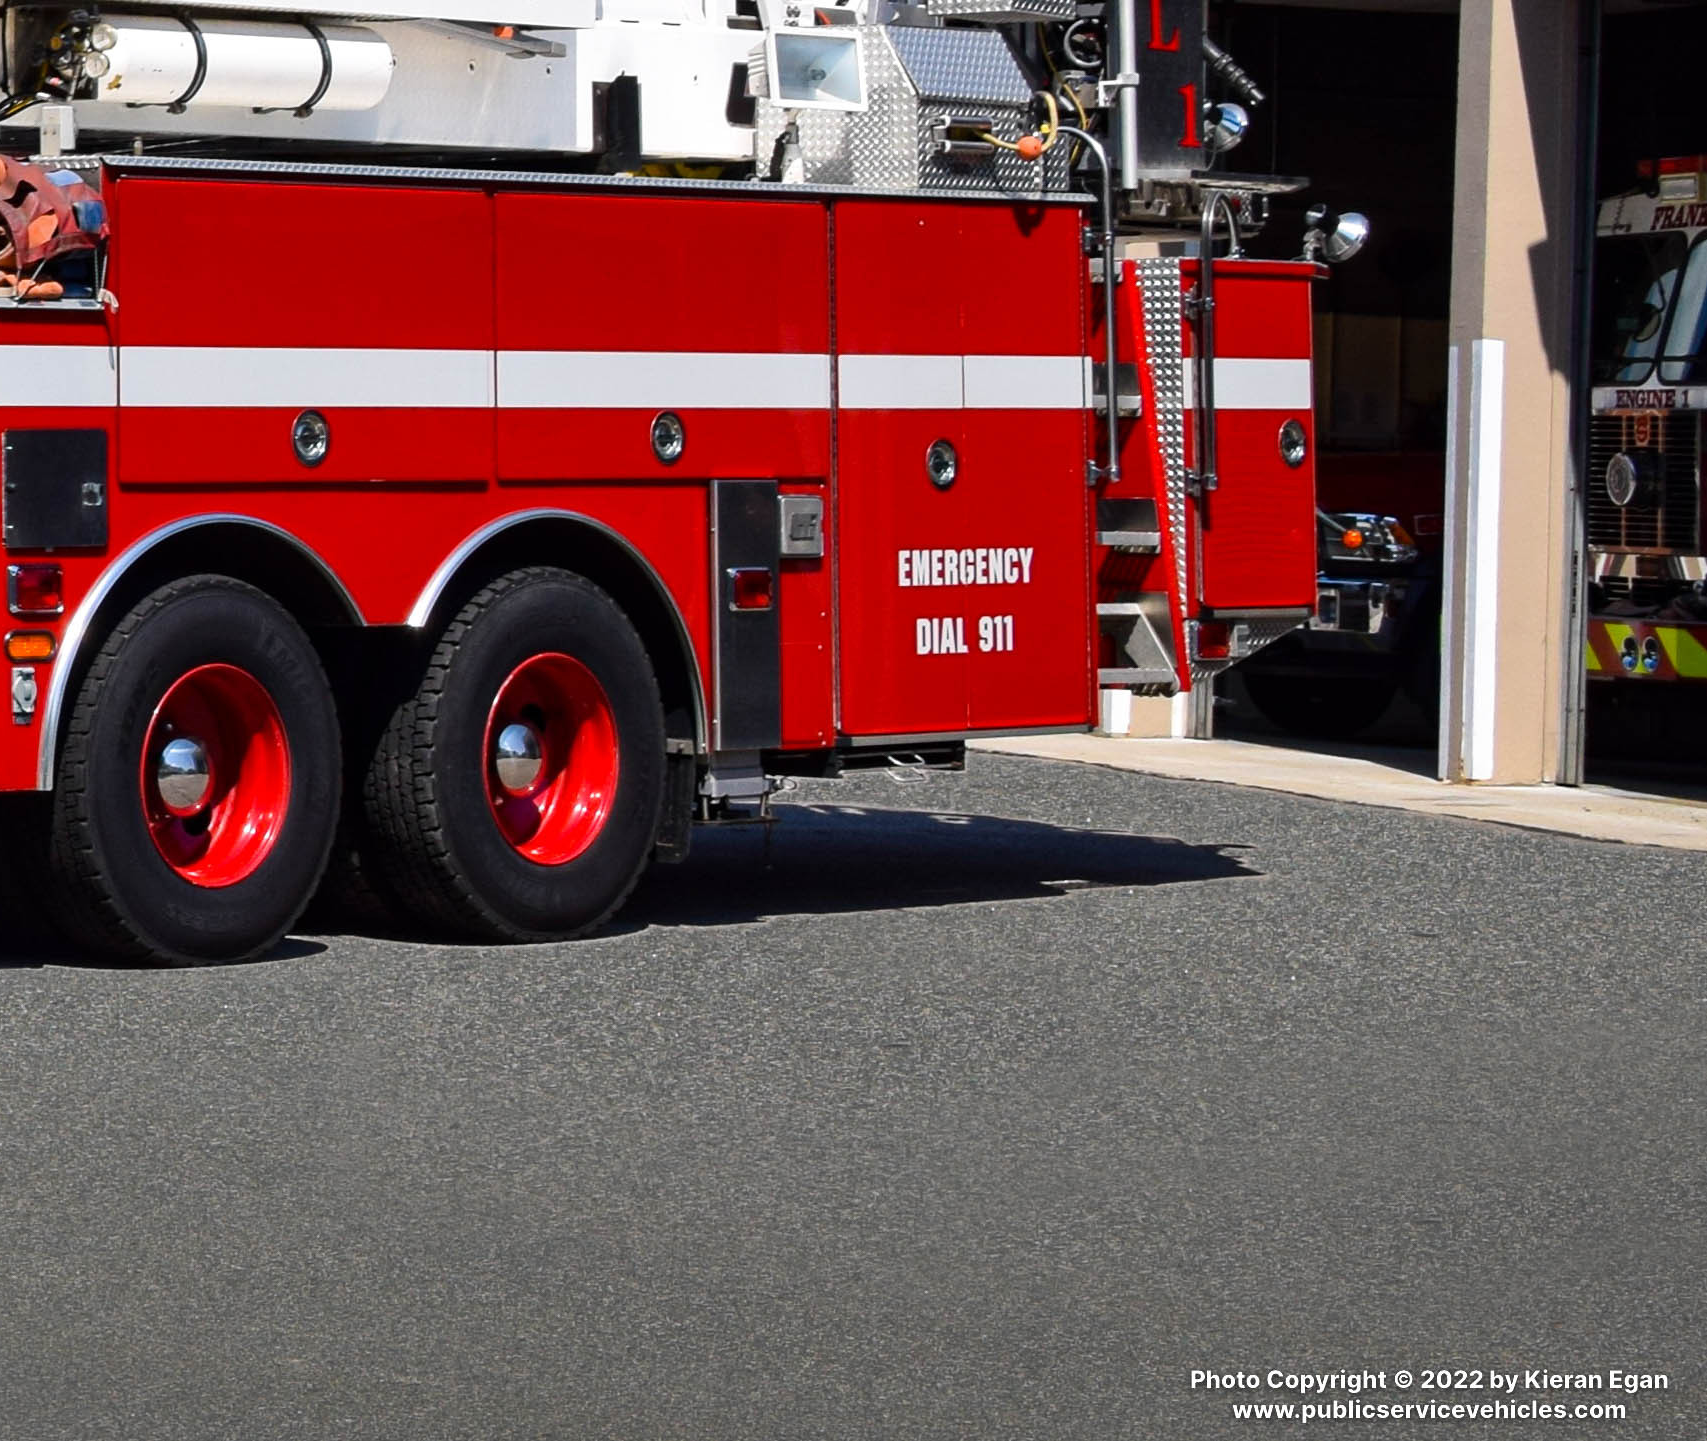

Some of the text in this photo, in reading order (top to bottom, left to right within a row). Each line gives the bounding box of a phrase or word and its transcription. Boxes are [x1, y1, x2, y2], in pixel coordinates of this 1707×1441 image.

[1616, 389, 1689, 409] ENGINE 1
[898, 547, 1034, 587] EMERGENCY
[916, 614, 1014, 656] DIAL 911
